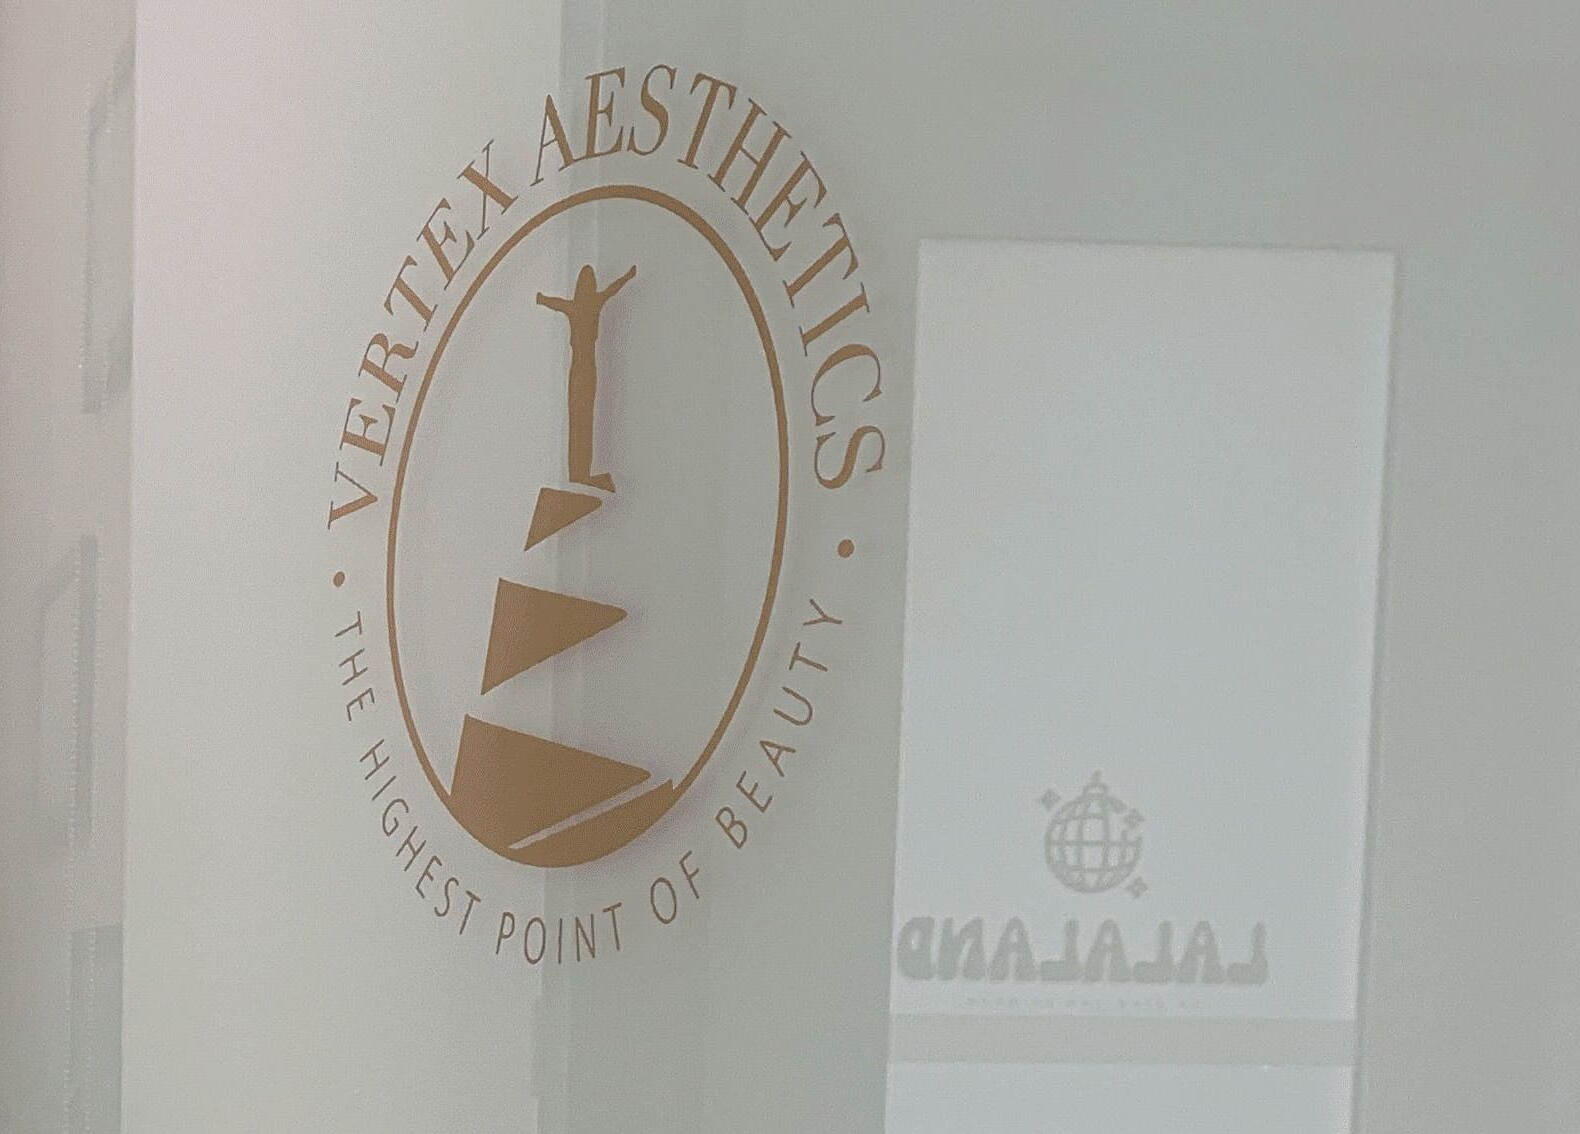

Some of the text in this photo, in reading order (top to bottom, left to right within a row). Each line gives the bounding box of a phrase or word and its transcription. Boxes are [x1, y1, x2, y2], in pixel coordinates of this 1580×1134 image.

[327, 63, 887, 530] VERTEX AESTHETICS
[335, 598, 844, 965] THE HIGHEST POINT OF BEAUTY
